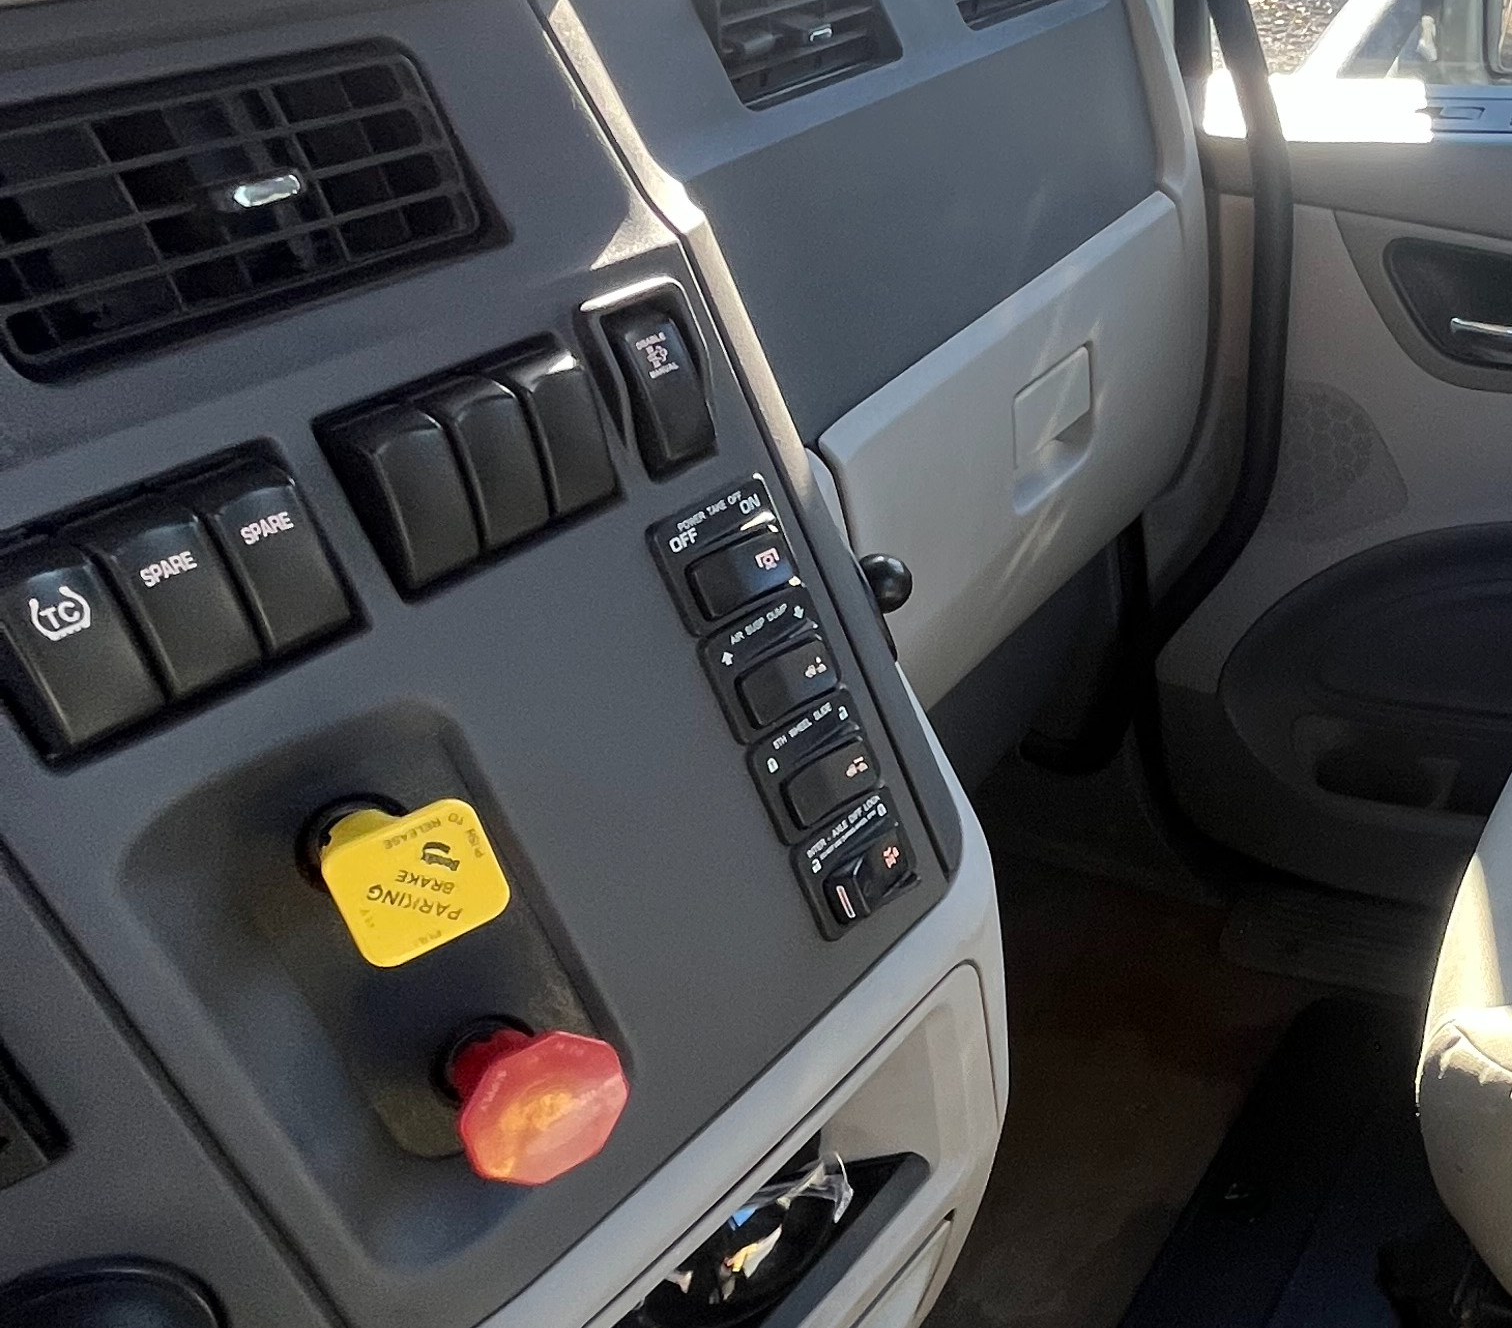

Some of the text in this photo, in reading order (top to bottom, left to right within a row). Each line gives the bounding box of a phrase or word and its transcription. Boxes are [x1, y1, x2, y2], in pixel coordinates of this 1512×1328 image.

[677, 511, 707, 532] POWER
[706, 499, 727, 516] TAKE
[739, 493, 761, 515] ON
[240, 511, 294, 546] SPARE
[668, 527, 698, 553] OFF
[139, 551, 198, 588] SPARE
[39, 600, 81, 630] TC
[730, 631, 745, 646] AIR
[383, 817, 442, 850] RELEASE
[447, 811, 465, 826] TO
[394, 869, 456, 895] BRAKE
[366, 884, 464, 921] PARKING
